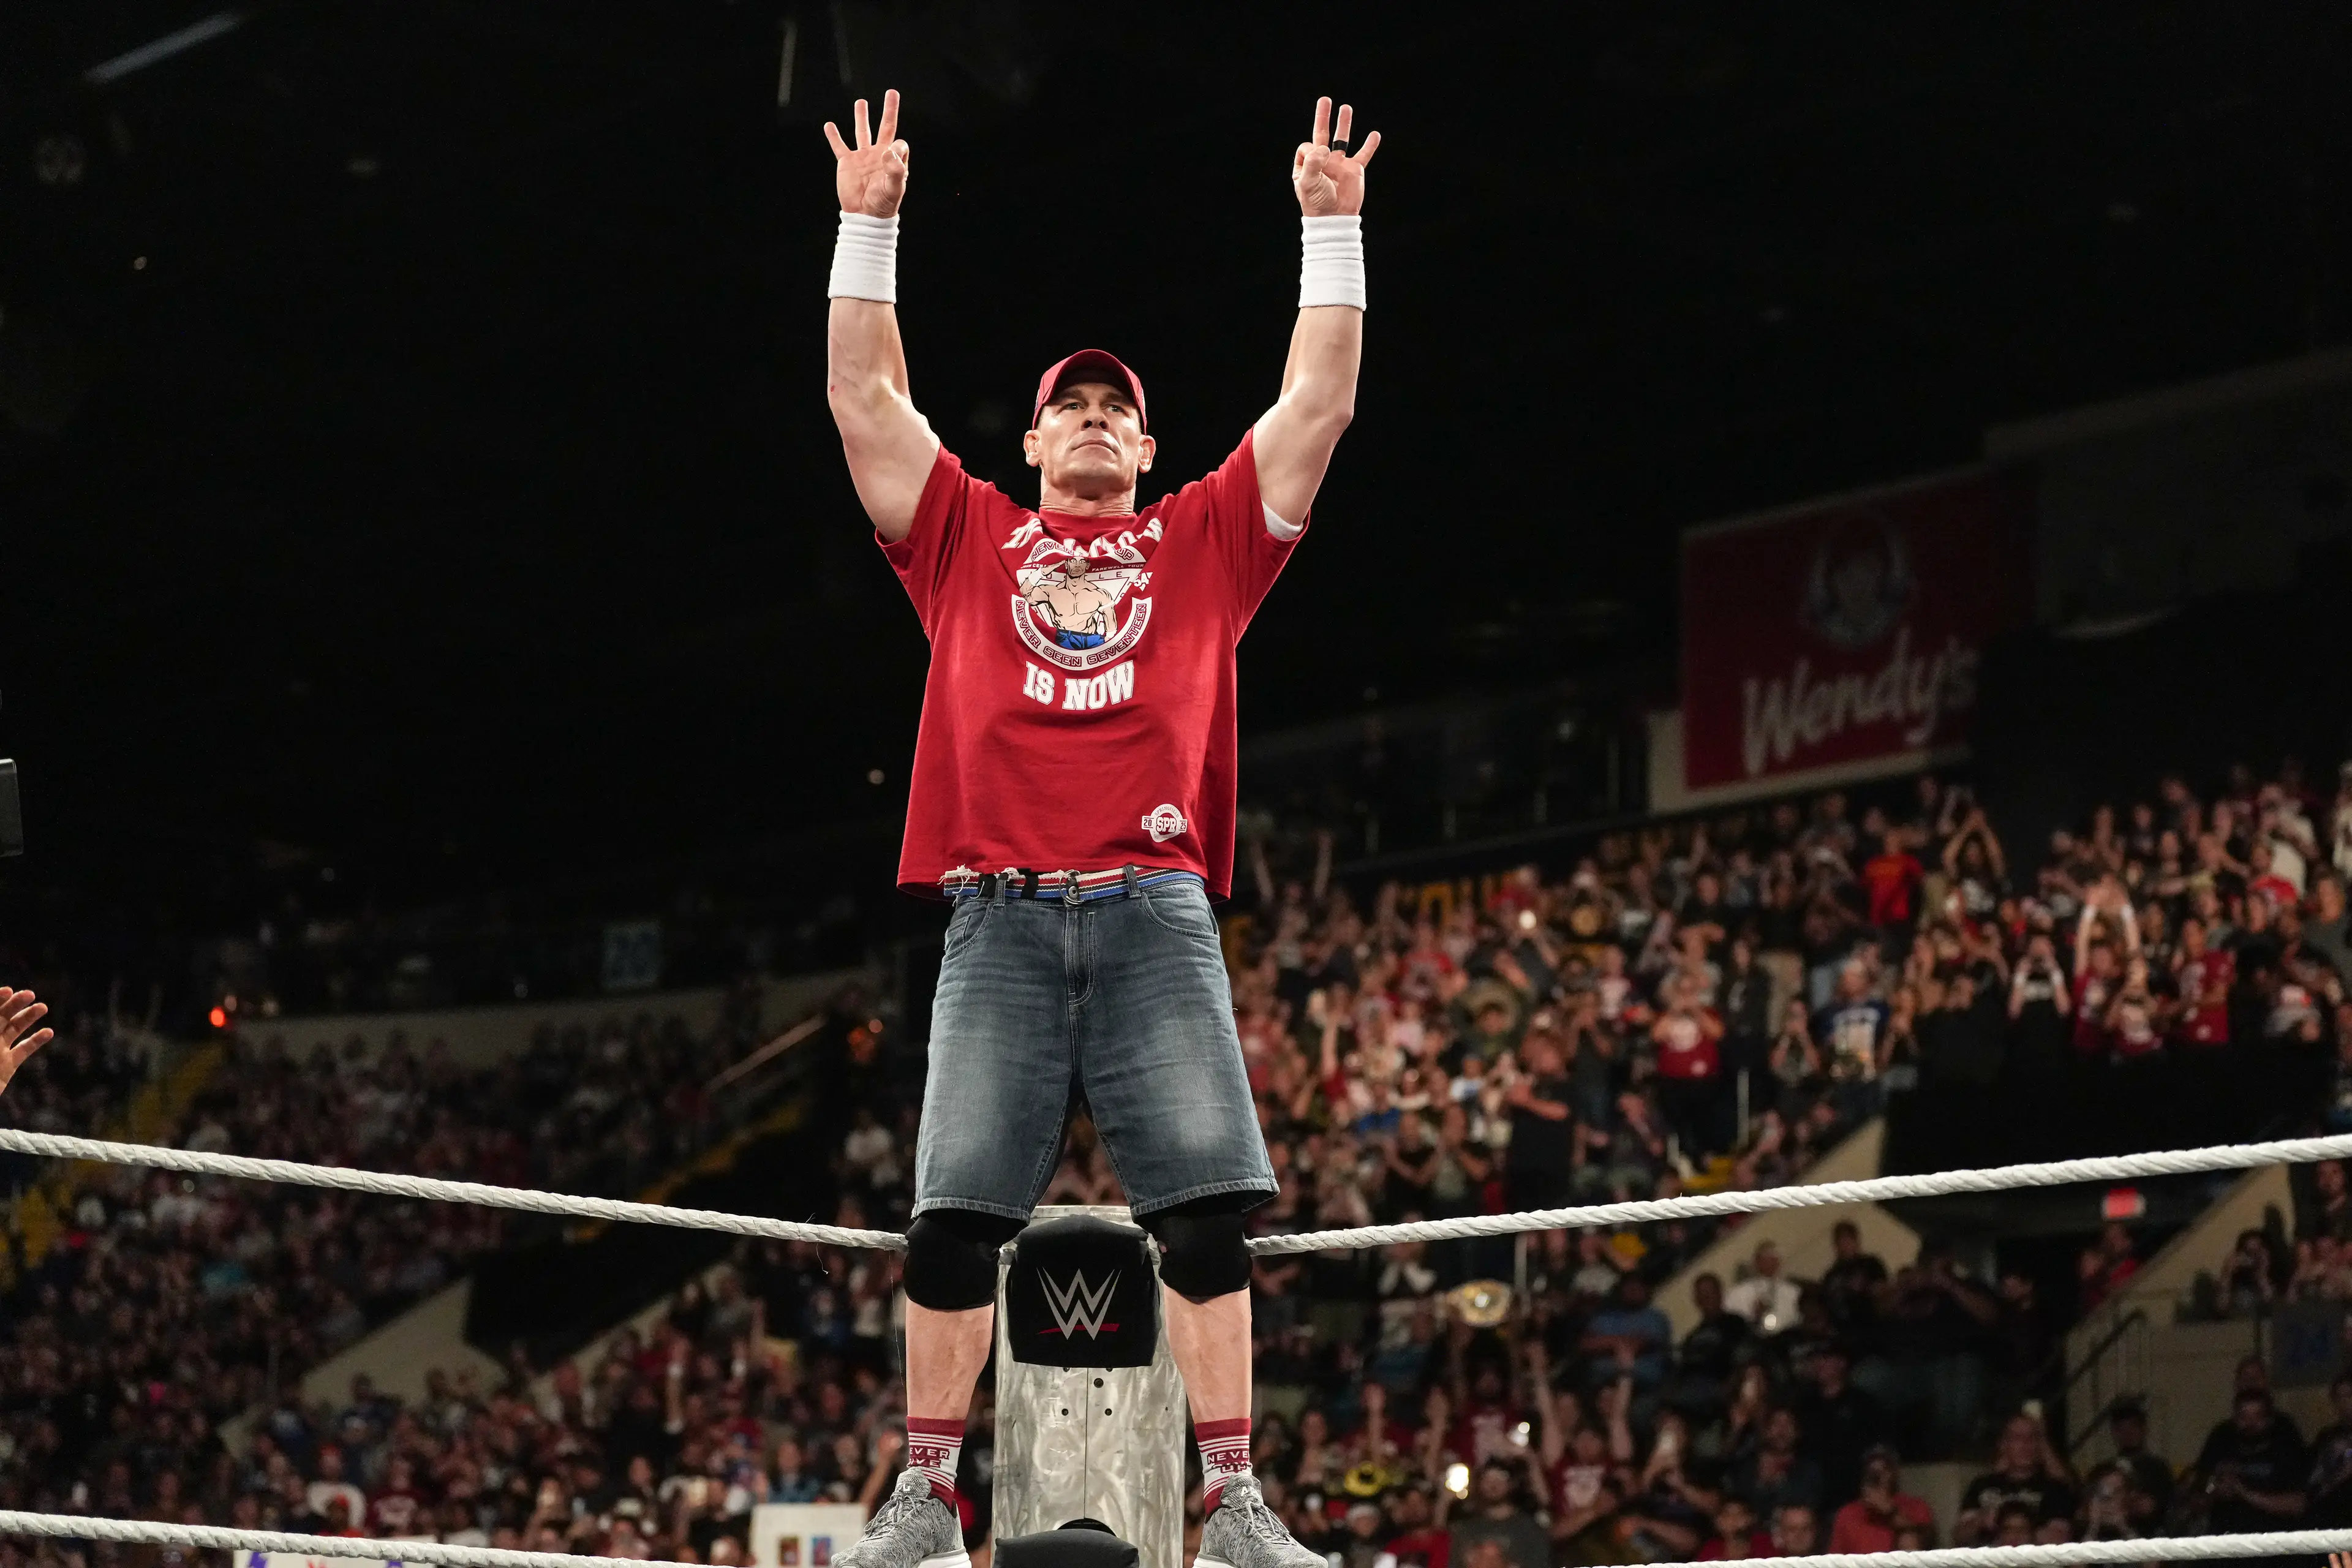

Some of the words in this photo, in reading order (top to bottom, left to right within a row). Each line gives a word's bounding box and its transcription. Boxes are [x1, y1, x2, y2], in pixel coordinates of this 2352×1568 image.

[1016, 600, 1041, 649] NEVER
[1043, 646, 1082, 667] SEEN
[1086, 603, 1147, 663] SEVENTEEN
[1022, 661, 1055, 706] IS
[1061, 660, 1134, 710] NOW
[1740, 627, 1982, 777] Wendy's
[1156, 816, 1177, 833] SPR
[910, 1447, 949, 1459] EVER
[1207, 1450, 1249, 1464] NEVE
